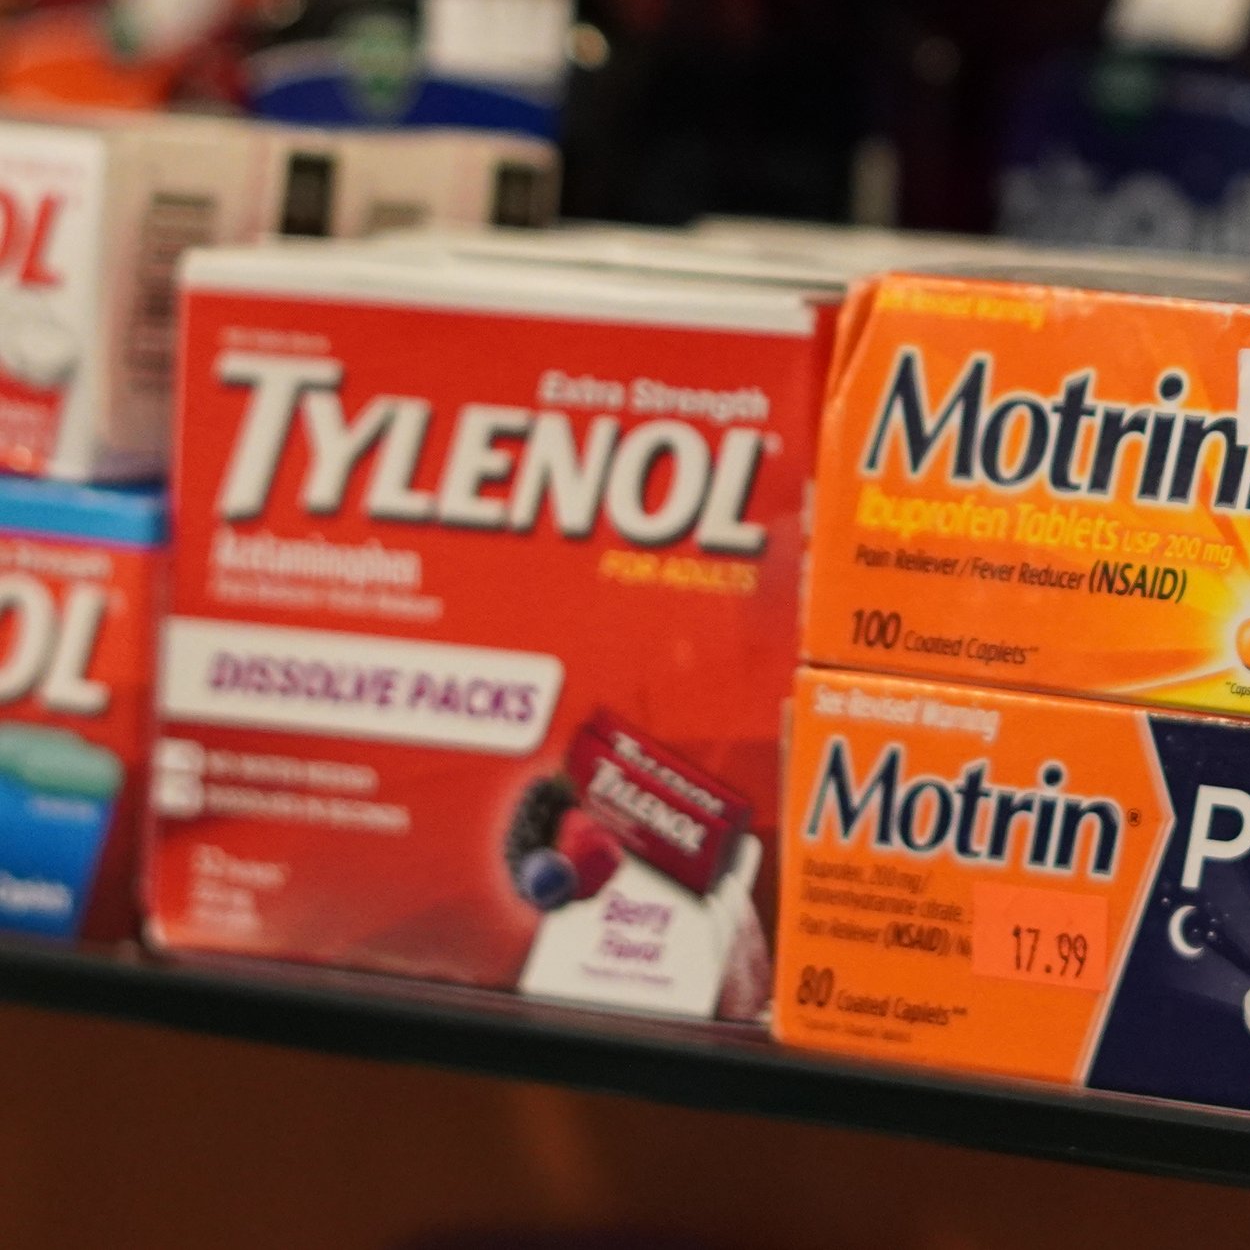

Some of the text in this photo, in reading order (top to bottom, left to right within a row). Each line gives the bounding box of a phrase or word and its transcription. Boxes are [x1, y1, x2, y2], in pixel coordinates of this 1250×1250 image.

[540, 370, 767, 426] Extra Strength
[212, 350, 766, 557] TYLENOL
[864, 352, 1248, 509] Motrin
[857, 485, 1234, 569] Ibuprofen Tablets 200 mg
[971, 557, 1188, 604] Fever Reducer (NSAID)
[853, 609, 900, 649] 100
[406, 672, 539, 723] PACKS
[807, 740, 1119, 875] Motrin
[1012, 925, 1087, 978] 17.99
